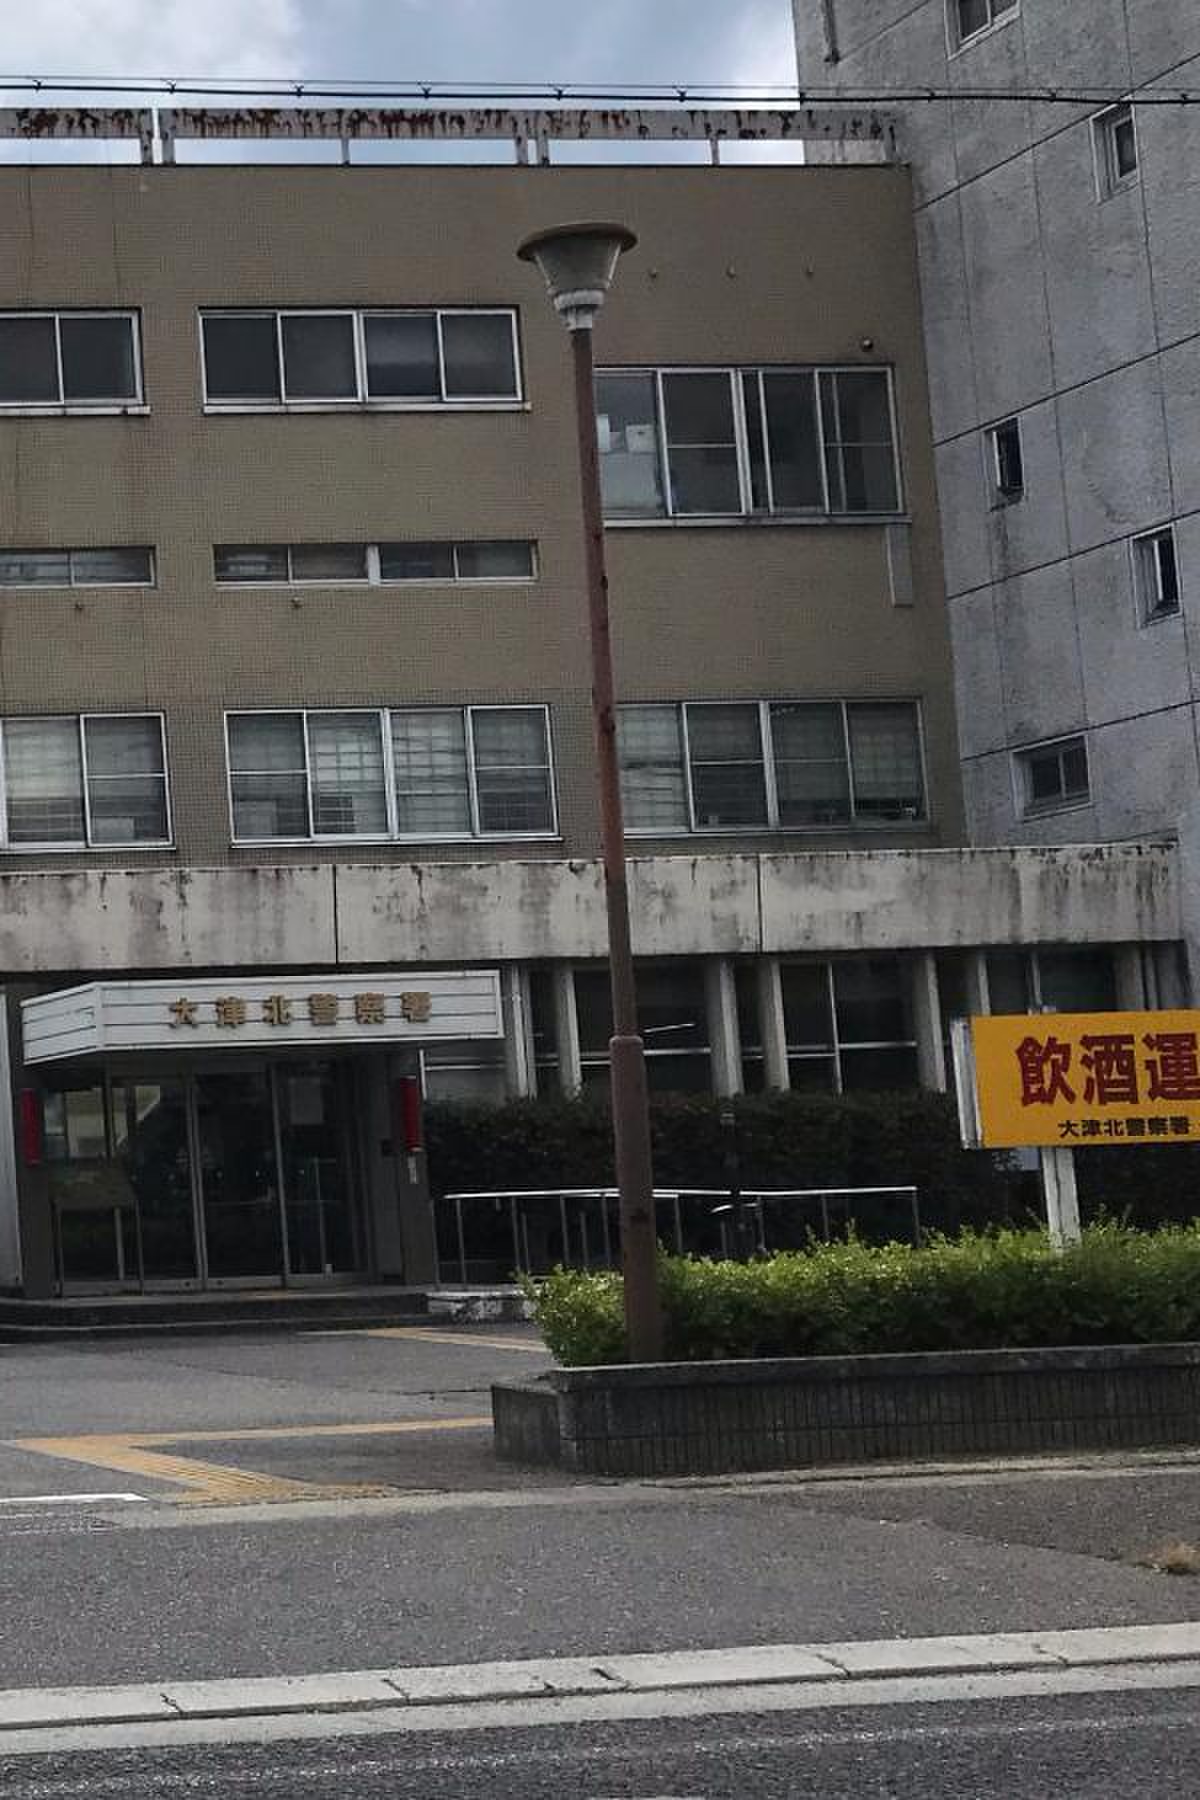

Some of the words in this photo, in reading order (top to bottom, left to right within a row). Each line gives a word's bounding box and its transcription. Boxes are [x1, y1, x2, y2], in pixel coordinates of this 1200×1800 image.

[169, 991, 433, 1029] 大津北警察署
[1015, 1032, 1200, 1107] 飲酒運
[1057, 1115, 1191, 1139] 大津北警察署
